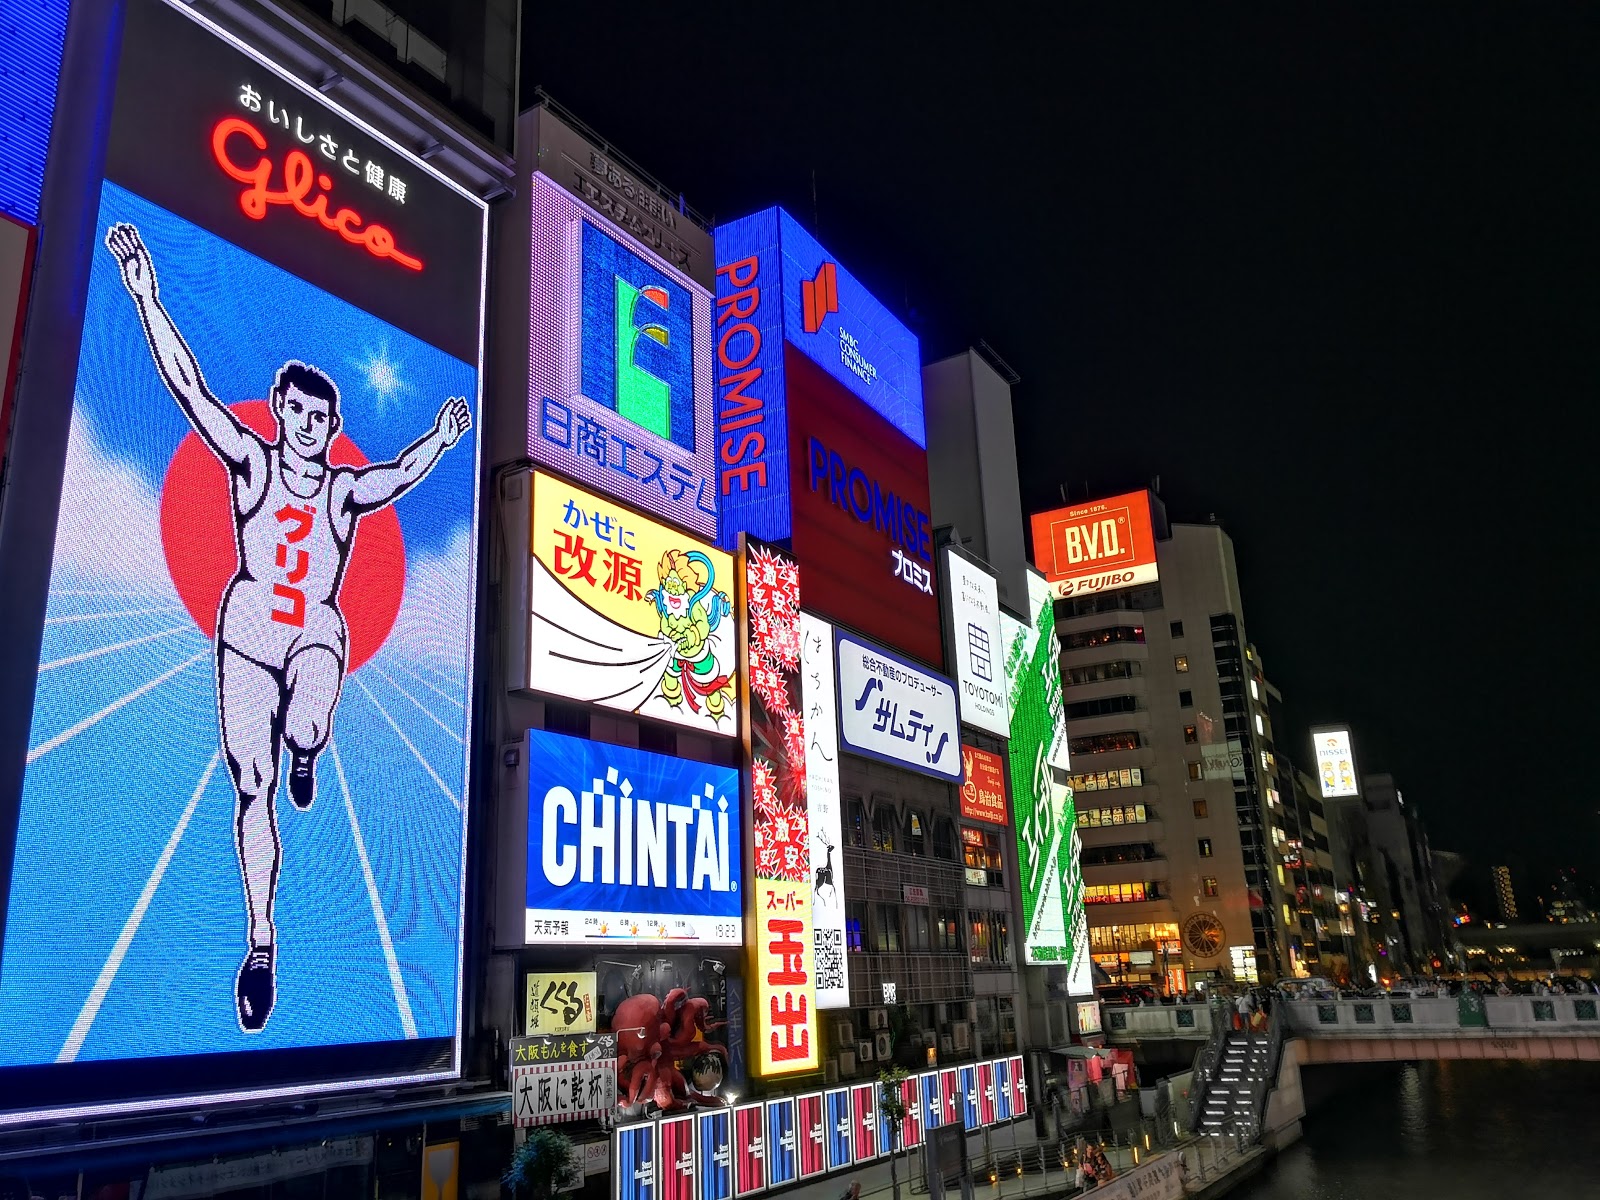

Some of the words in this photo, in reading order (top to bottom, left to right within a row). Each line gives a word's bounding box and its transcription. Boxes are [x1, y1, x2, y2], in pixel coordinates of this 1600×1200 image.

[239, 84, 408, 205] おいしさと健康
[211, 117, 423, 273] Glico
[839, 326, 859, 352] SMBC
[840, 340, 878, 380] CONSUMER
[716, 255, 767, 496] PROMISE
[841, 351, 871, 386] FINANCE
[809, 435, 931, 562] PROMISE
[1070, 507, 1088, 517] Since
[563, 499, 636, 551] かぜに
[1065, 518, 1126, 564] B.V.D.
[271, 503, 317, 629] グリコ
[553, 528, 643, 602] 改源
[891, 549, 934, 596] プロミス
[1077, 571, 1135, 592] FUJIBO
[862, 653, 942, 697] 総合不動産のプロデューサー
[542, 766, 730, 892] CHINTAI
[766, 890, 804, 911] スーパー
[768, 919, 810, 1062] 玉出
[602, 1048, 615, 1059] 2F
[519, 1070, 603, 1116] 大阪に乾杯
